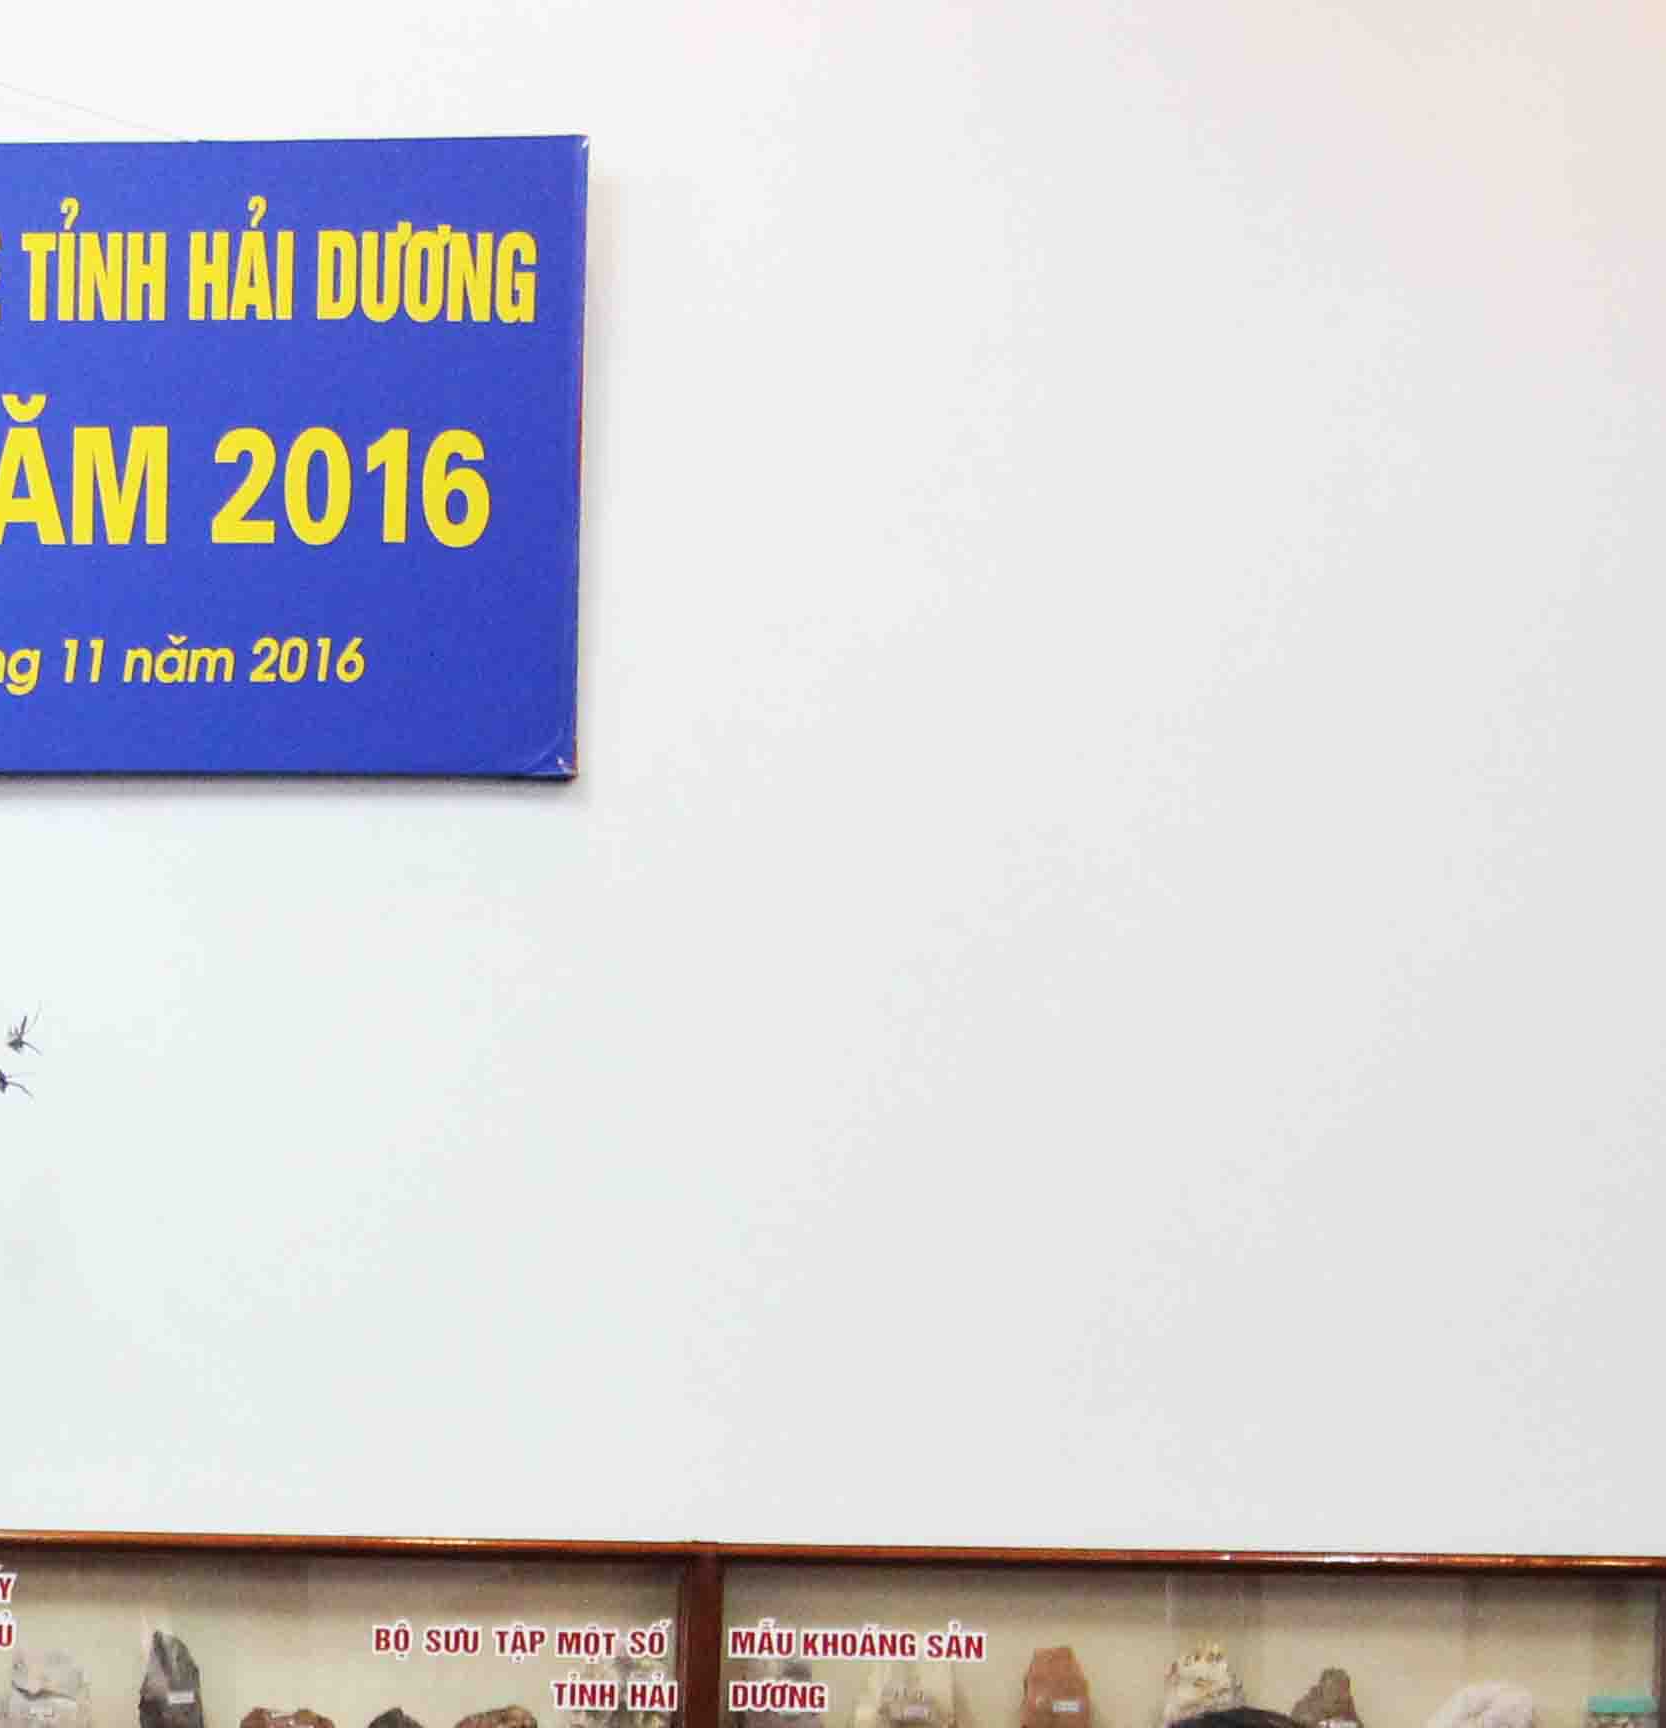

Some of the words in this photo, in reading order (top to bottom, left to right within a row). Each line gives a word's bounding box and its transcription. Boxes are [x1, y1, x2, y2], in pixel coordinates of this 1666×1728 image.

[21, 196, 167, 322] TỈNH
[188, 194, 295, 321] HẢI
[316, 220, 538, 323] DƯƠNG
[211, 426, 492, 549] 2016
[64, 638, 105, 683] 11
[123, 635, 235, 684] năm
[251, 635, 366, 684] 2016
[374, 1622, 412, 1658] BỘ
[425, 1627, 481, 1655] SƯU
[495, 1623, 547, 1661] TẬP
[556, 1626, 617, 1662] MỘT
[628, 1620, 671, 1657] SỐ
[730, 1619, 796, 1658] MẪU
[800, 1624, 918, 1658] KHOÁNG
[926, 1622, 986, 1661] SẢN
[554, 1673, 617, 1709] TỈNH
[629, 1672, 678, 1711] HẢI
[730, 1680, 827, 1711] DƯƠNG
